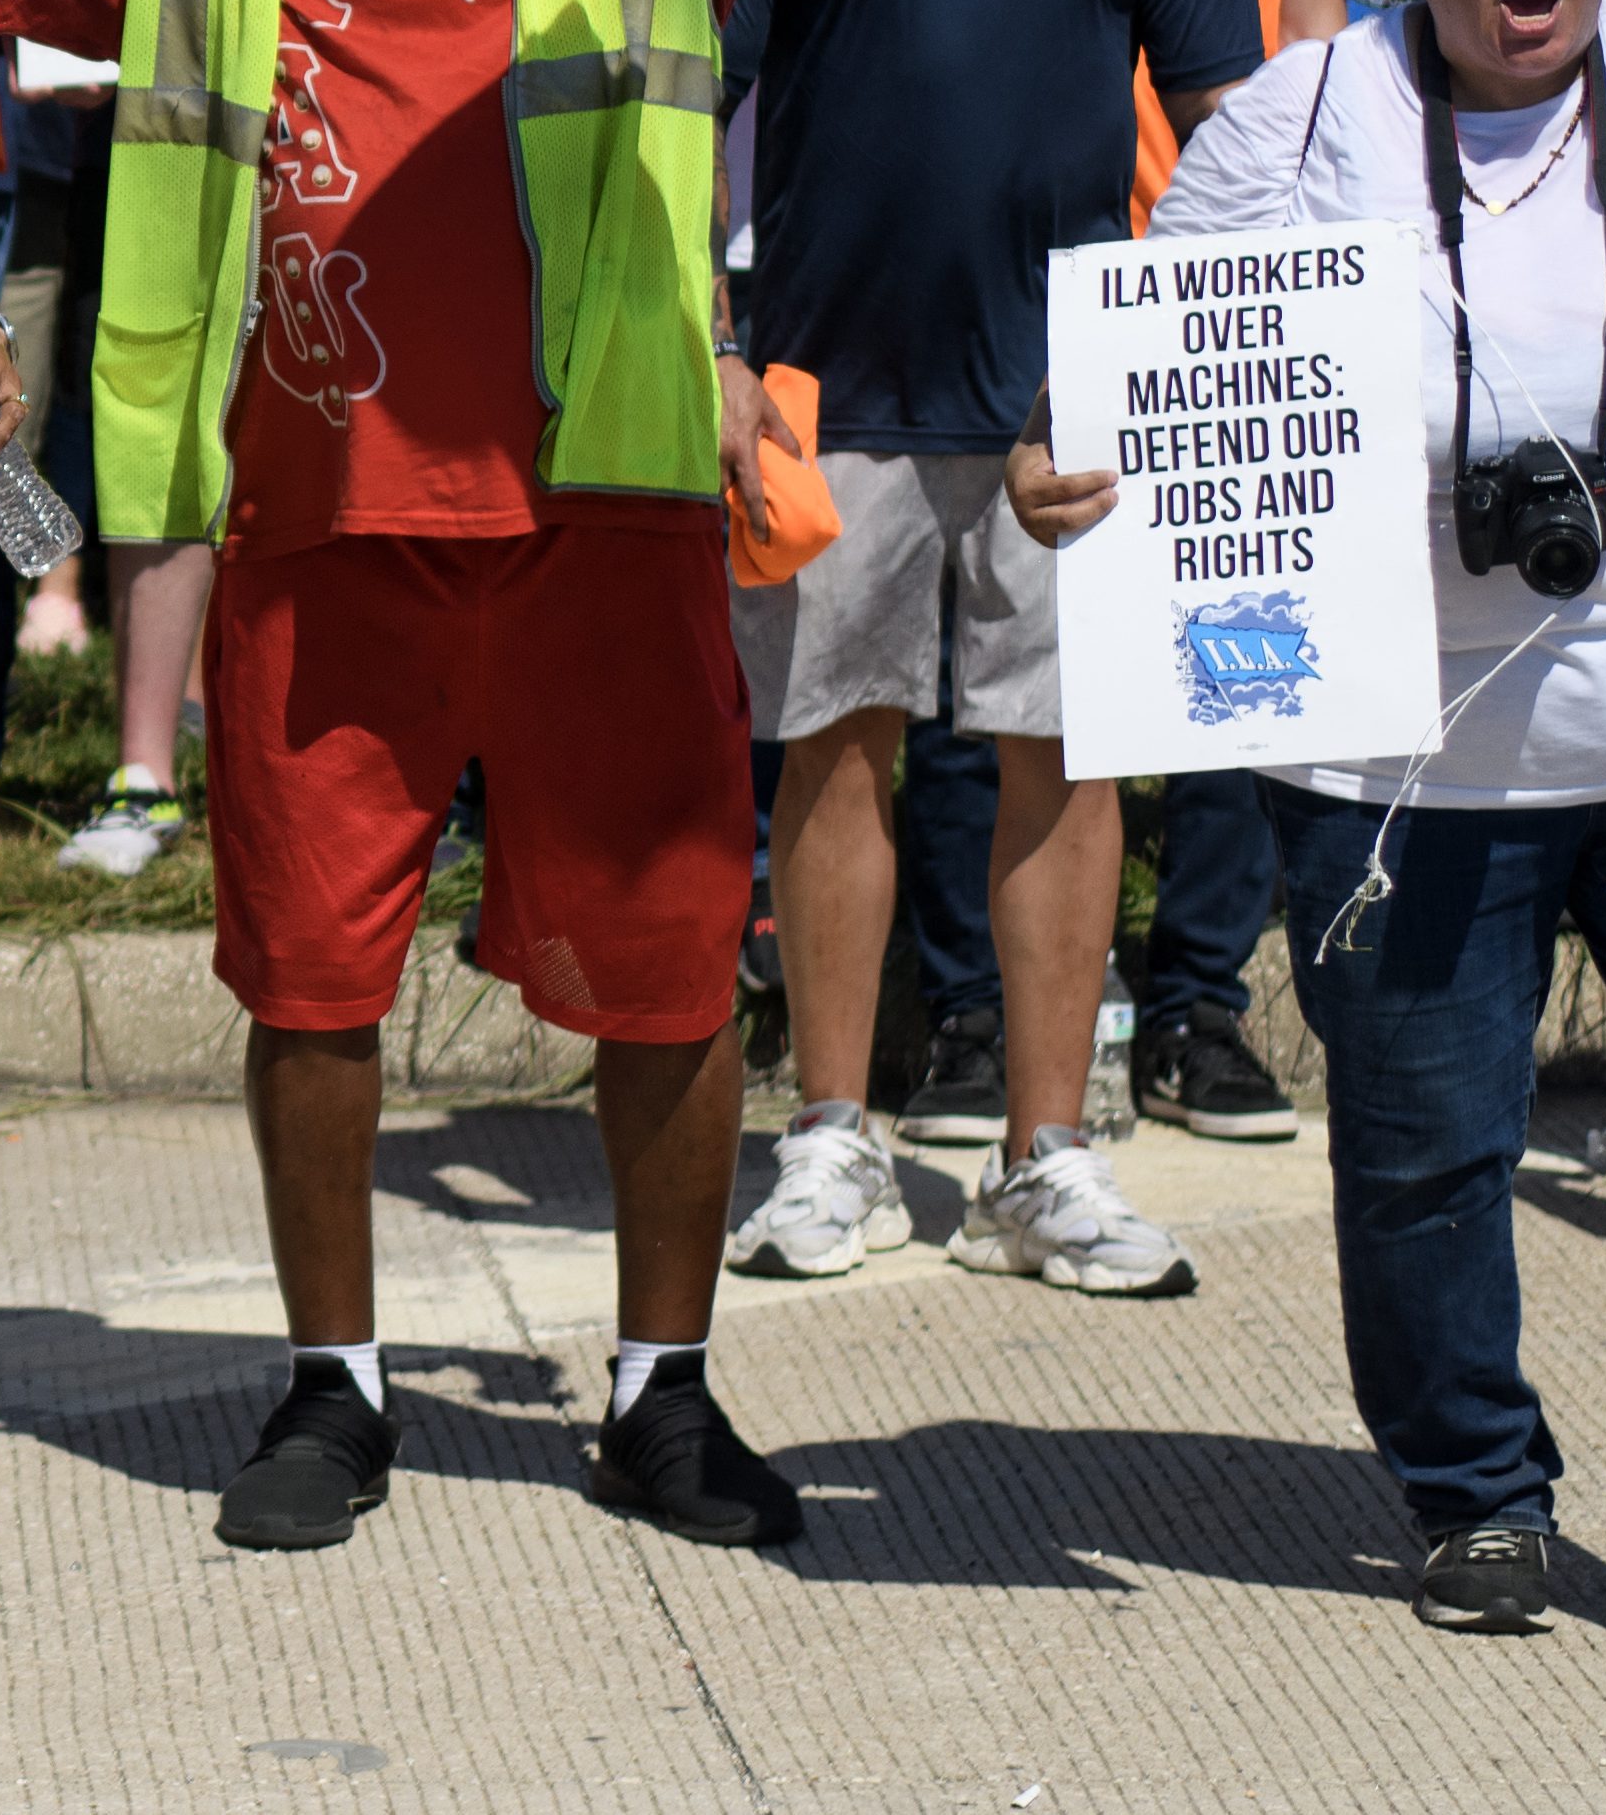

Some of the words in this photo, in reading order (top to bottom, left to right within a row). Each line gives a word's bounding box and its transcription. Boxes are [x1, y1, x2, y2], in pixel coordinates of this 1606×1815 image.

[1100, 266, 1160, 310] ILA
[1172, 244, 1366, 303] WORKERS
[1181, 304, 1286, 356] OVER
[1126, 353, 1345, 418] MACHINES:
[1117, 417, 1272, 477] DEFEND
[1281, 407, 1362, 457] OUR
[1148, 476, 1243, 529] JOBS
[1255, 468, 1335, 519] AND
[1532, 473, 1565, 483] Canon
[1172, 526, 1315, 583] RIGHTS
[1199, 635, 1293, 674] I.L.A.
